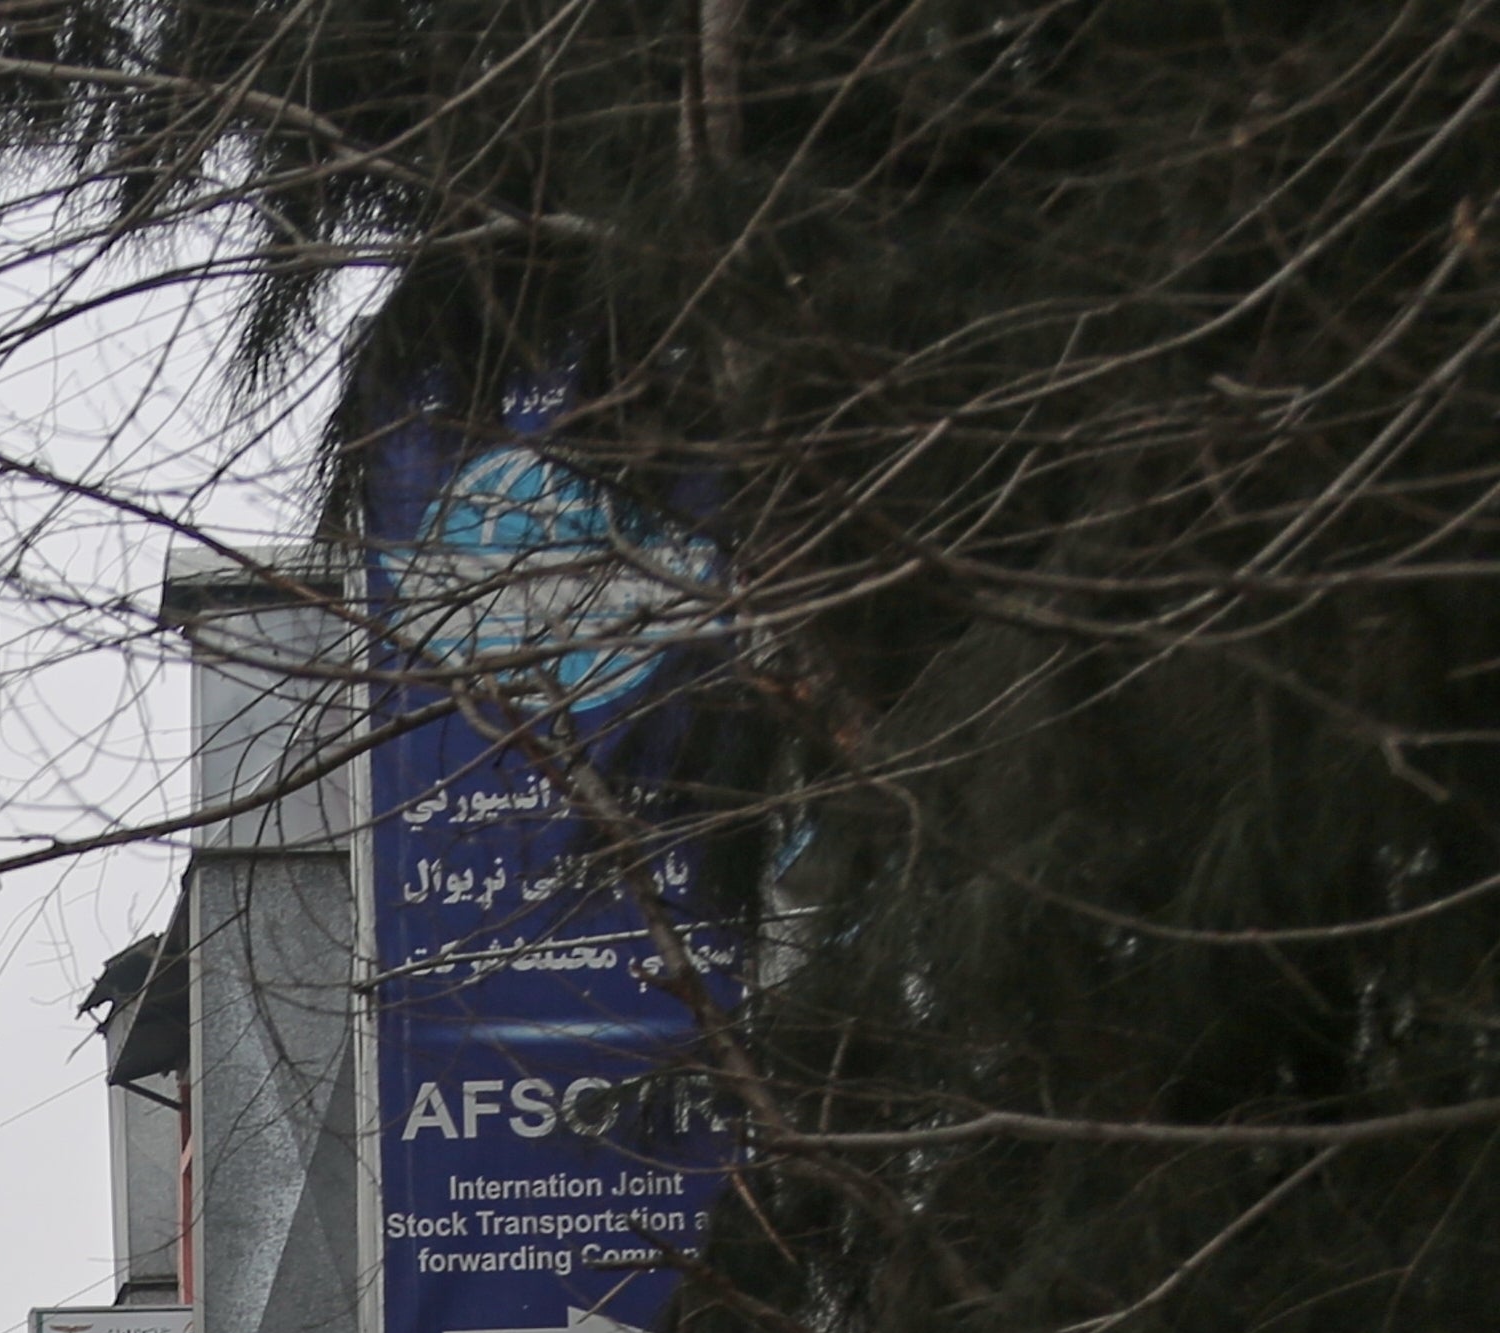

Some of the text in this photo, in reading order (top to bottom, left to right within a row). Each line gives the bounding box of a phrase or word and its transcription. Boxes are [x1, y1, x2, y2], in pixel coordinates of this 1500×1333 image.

[449, 1169, 684, 1202] Internation Joint
[387, 1211, 467, 1238] Stock
[475, 1207, 685, 1240] Transportation
[418, 1245, 573, 1276] forwarding
